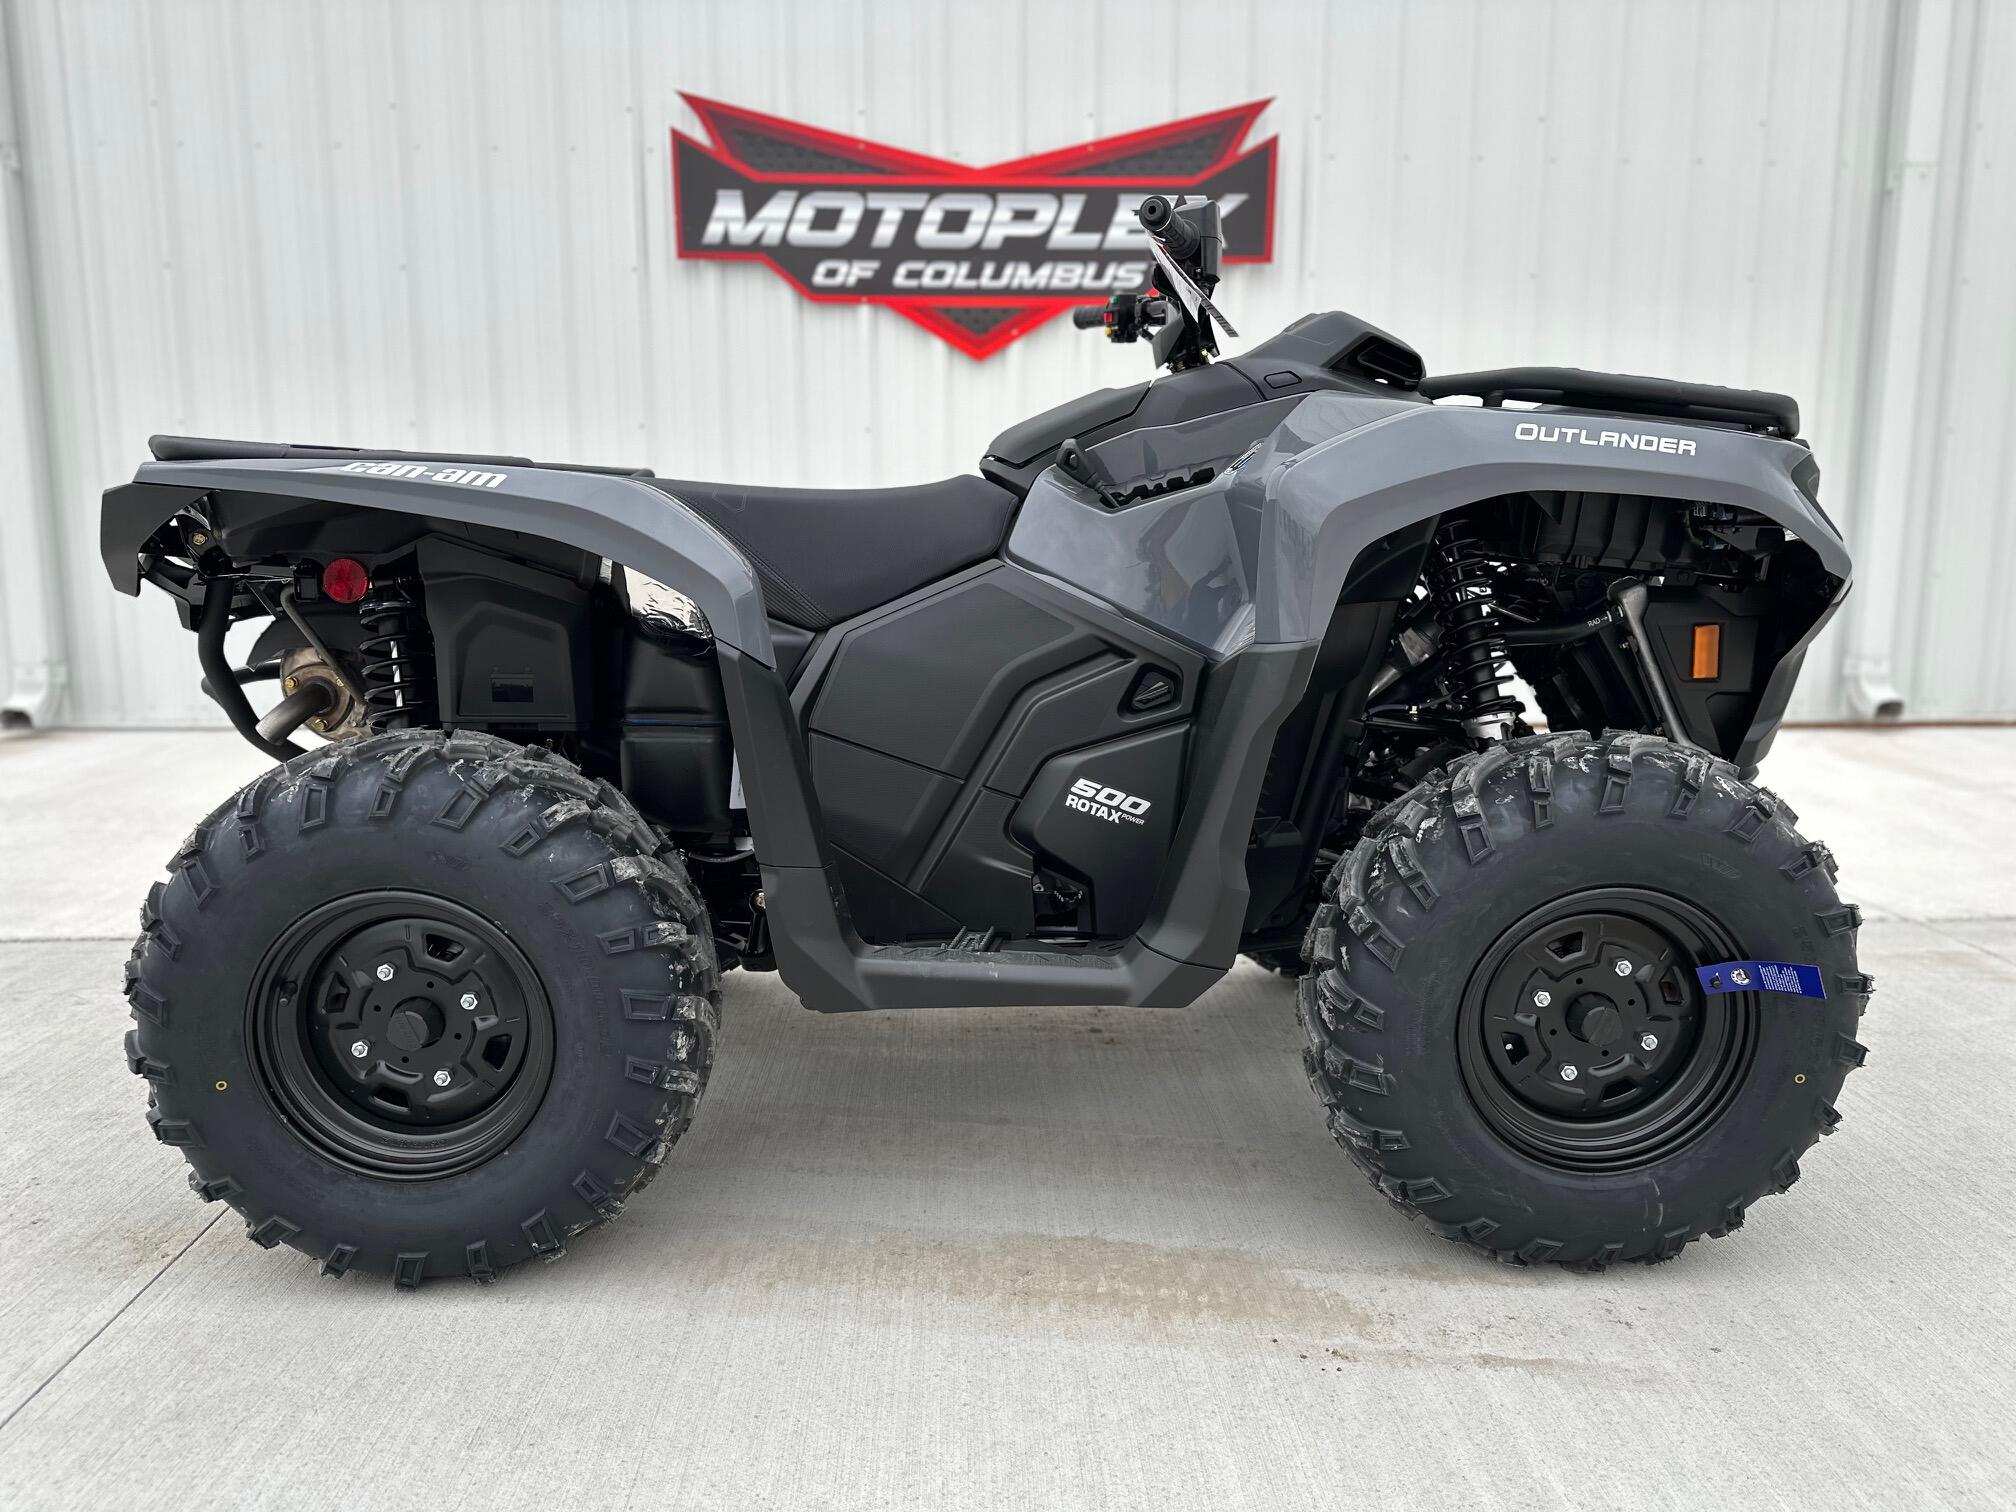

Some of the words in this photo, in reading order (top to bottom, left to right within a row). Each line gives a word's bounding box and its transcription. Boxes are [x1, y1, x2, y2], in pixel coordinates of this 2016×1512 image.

[812, 260, 877, 287] OF
[893, 260, 1148, 290] COLUMBUS
[1514, 423, 1697, 456] OUTLANDER
[340, 462, 508, 488] can-am
[1065, 794, 1122, 824] ROTAX
[1121, 813, 1145, 826] POWER
[1070, 777, 1151, 815] 500
